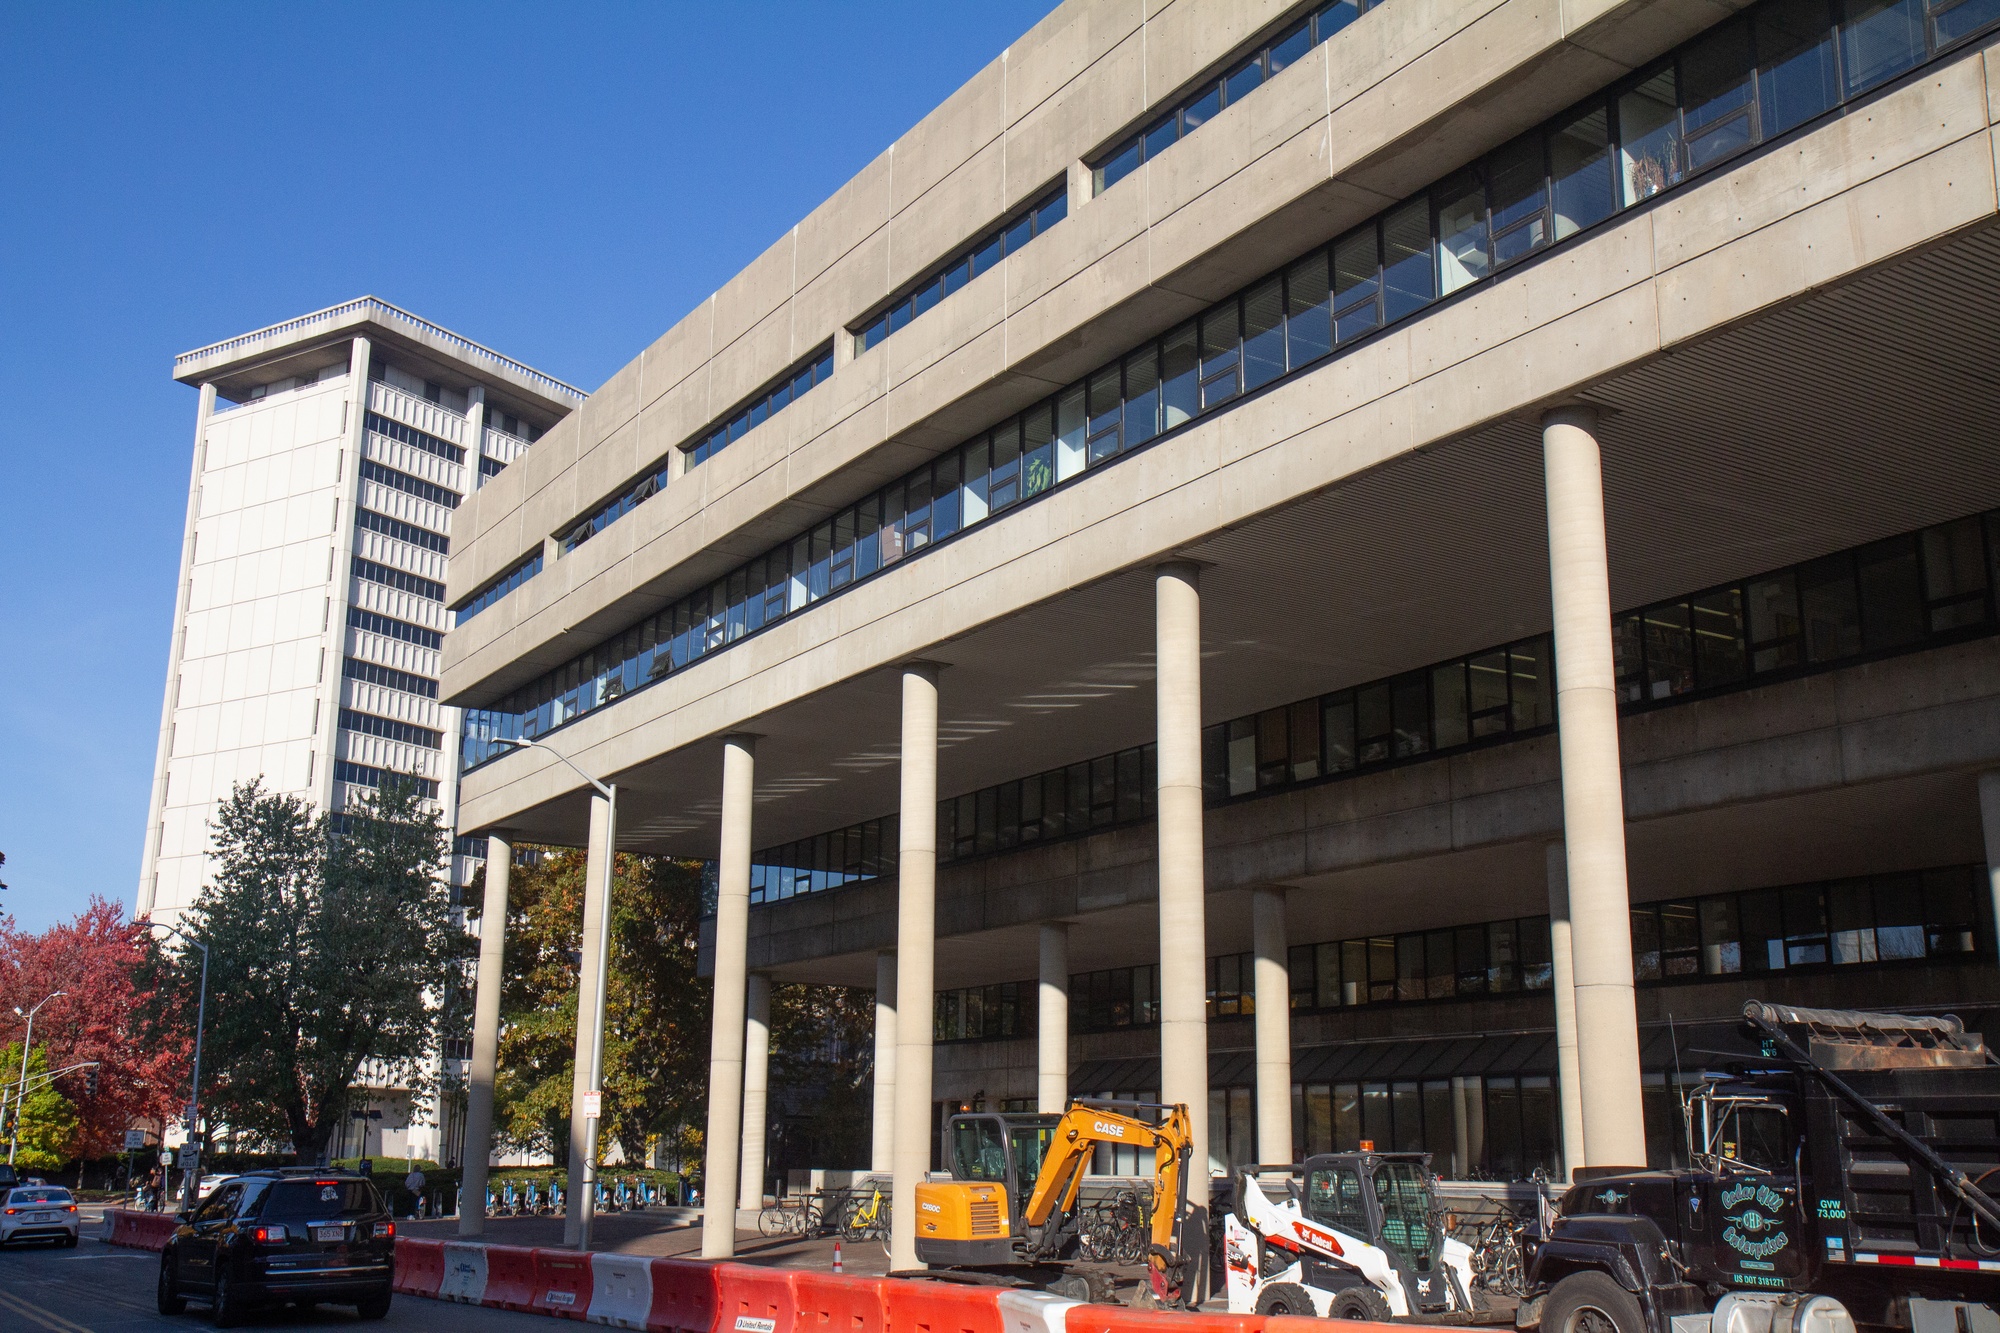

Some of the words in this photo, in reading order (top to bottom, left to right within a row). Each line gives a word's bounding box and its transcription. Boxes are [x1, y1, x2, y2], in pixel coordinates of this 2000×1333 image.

[1762, 1040, 1774, 1048] HT
[1094, 1121, 1124, 1137] CASE
[1608, 1191, 1614, 1202] 3
[1721, 1183, 1755, 1209] Cedar
[1756, 1185, 1784, 1212] Hill
[1819, 1199, 1841, 1209] GVW
[1816, 1208, 1846, 1219] 73,000
[1743, 1212, 1762, 1229] CHE
[1311, 1233, 1333, 1251] Bobcat
[1722, 1226, 1788, 1260] Enterprises
[1733, 1274, 1743, 1283] US
[1744, 1275, 1757, 1285] DOT
[742, 1320, 757, 1329] United
[757, 1321, 772, 1331] Rentals
